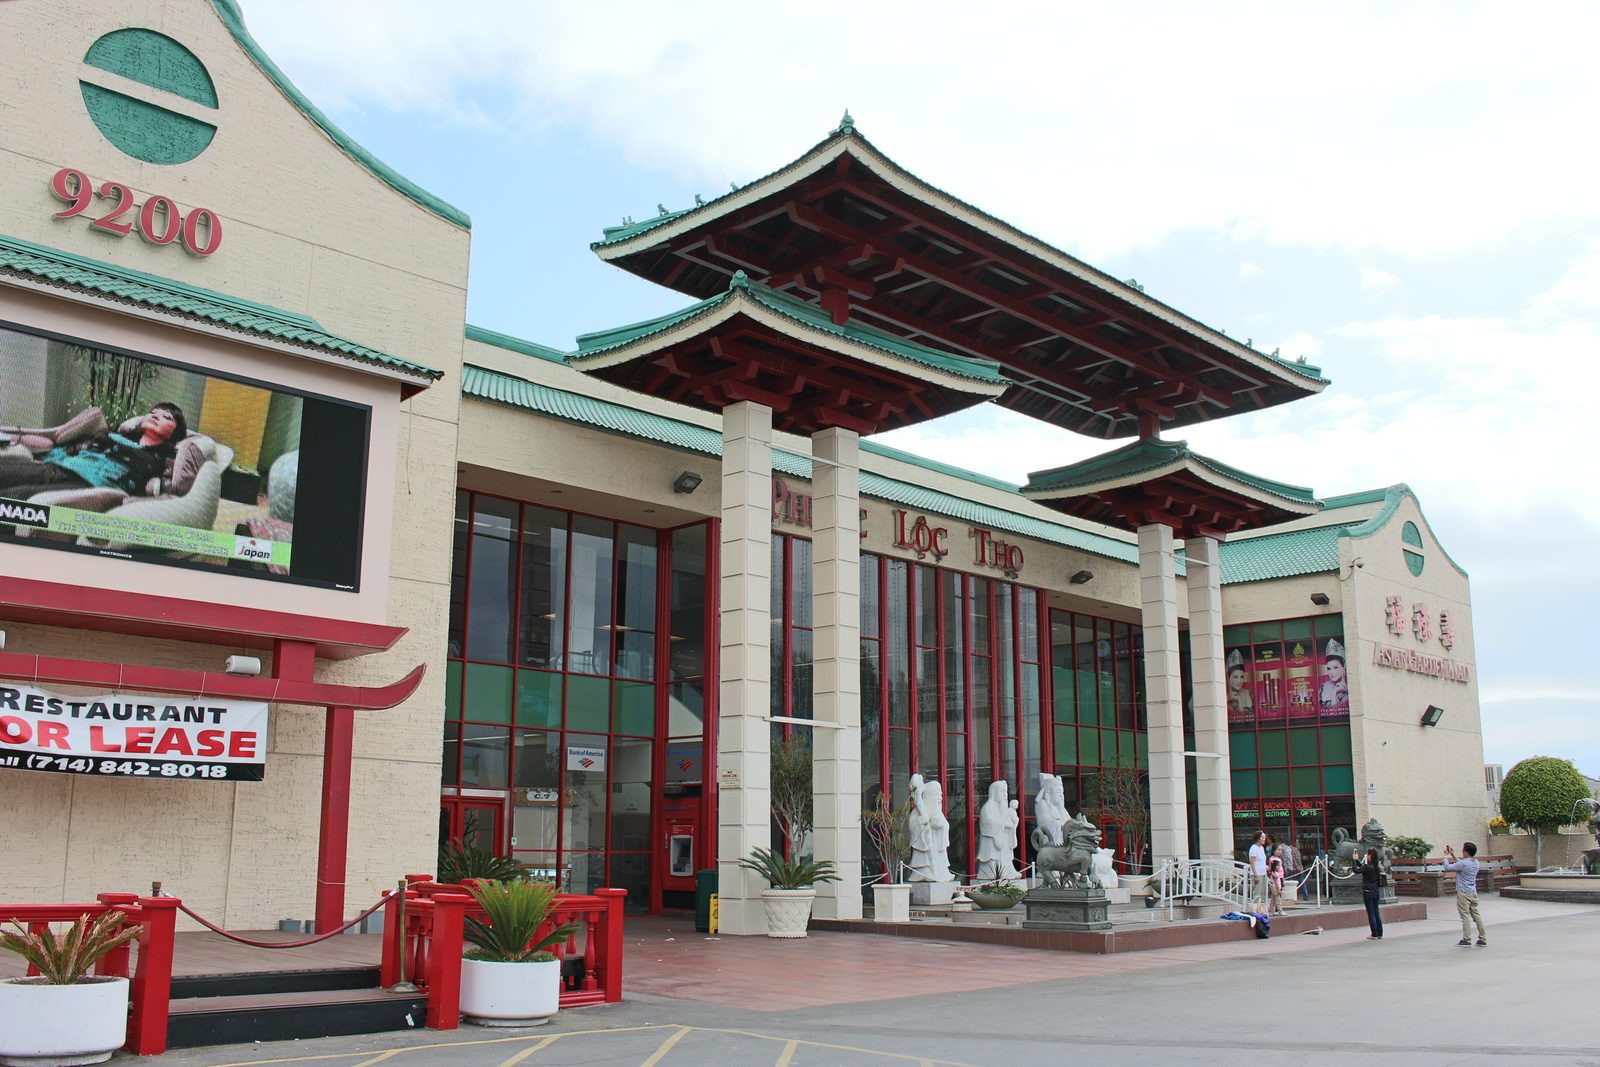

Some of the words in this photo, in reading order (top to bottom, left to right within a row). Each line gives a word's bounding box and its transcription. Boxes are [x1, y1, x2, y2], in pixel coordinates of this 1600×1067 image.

[51, 168, 223, 257] 9200
[238, 545, 271, 559] Japan
[0, 687, 227, 724] RESTAURANT
[89, 725, 257, 758] LEASE
[27, 753, 94, 772] (714)
[99, 759, 227, 779] 842-8018
[1265, 810, 1290, 818] CLOTHING
[1300, 809, 1317, 817] GIFTS
